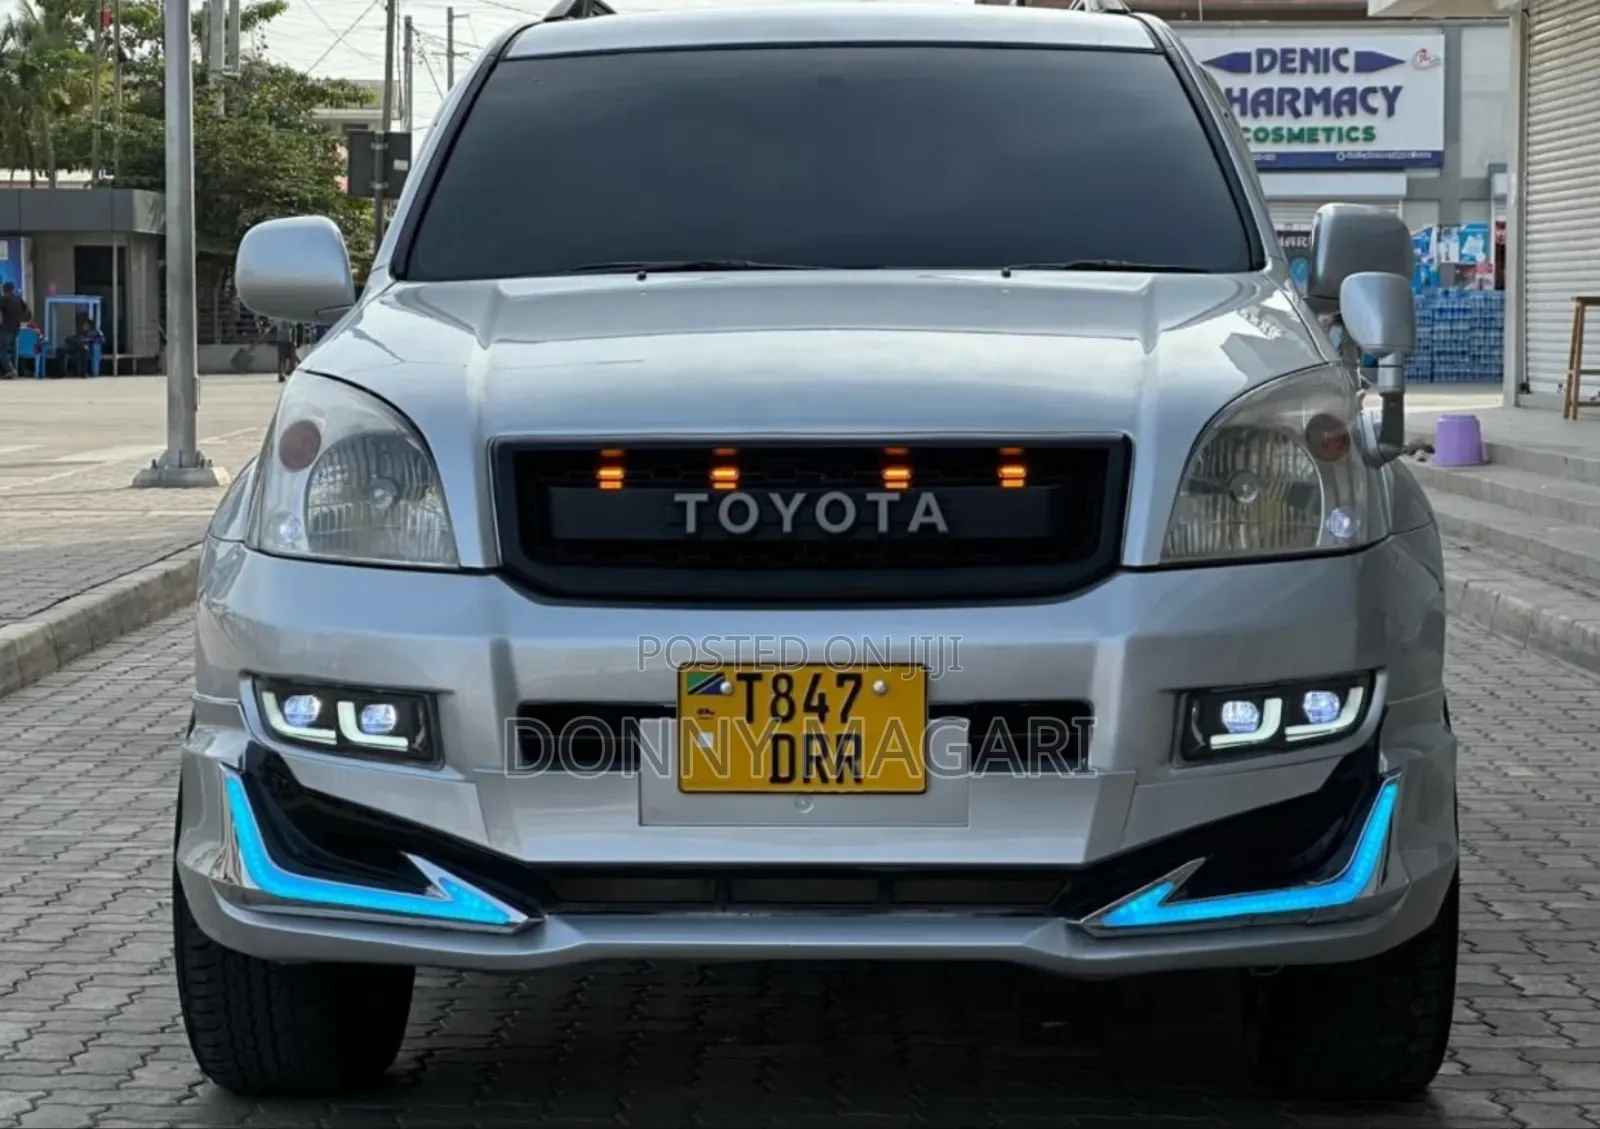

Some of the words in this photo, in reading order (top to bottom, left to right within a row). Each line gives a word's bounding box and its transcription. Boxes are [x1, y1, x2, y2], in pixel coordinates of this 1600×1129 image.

[1255, 47, 1350, 75] DENIC
[1224, 85, 1403, 119] HARMACY
[1241, 126, 1377, 144] COSMETICS
[674, 491, 949, 534] TOYOTA
[736, 672, 864, 725] T847
[768, 733, 864, 785] DRR
